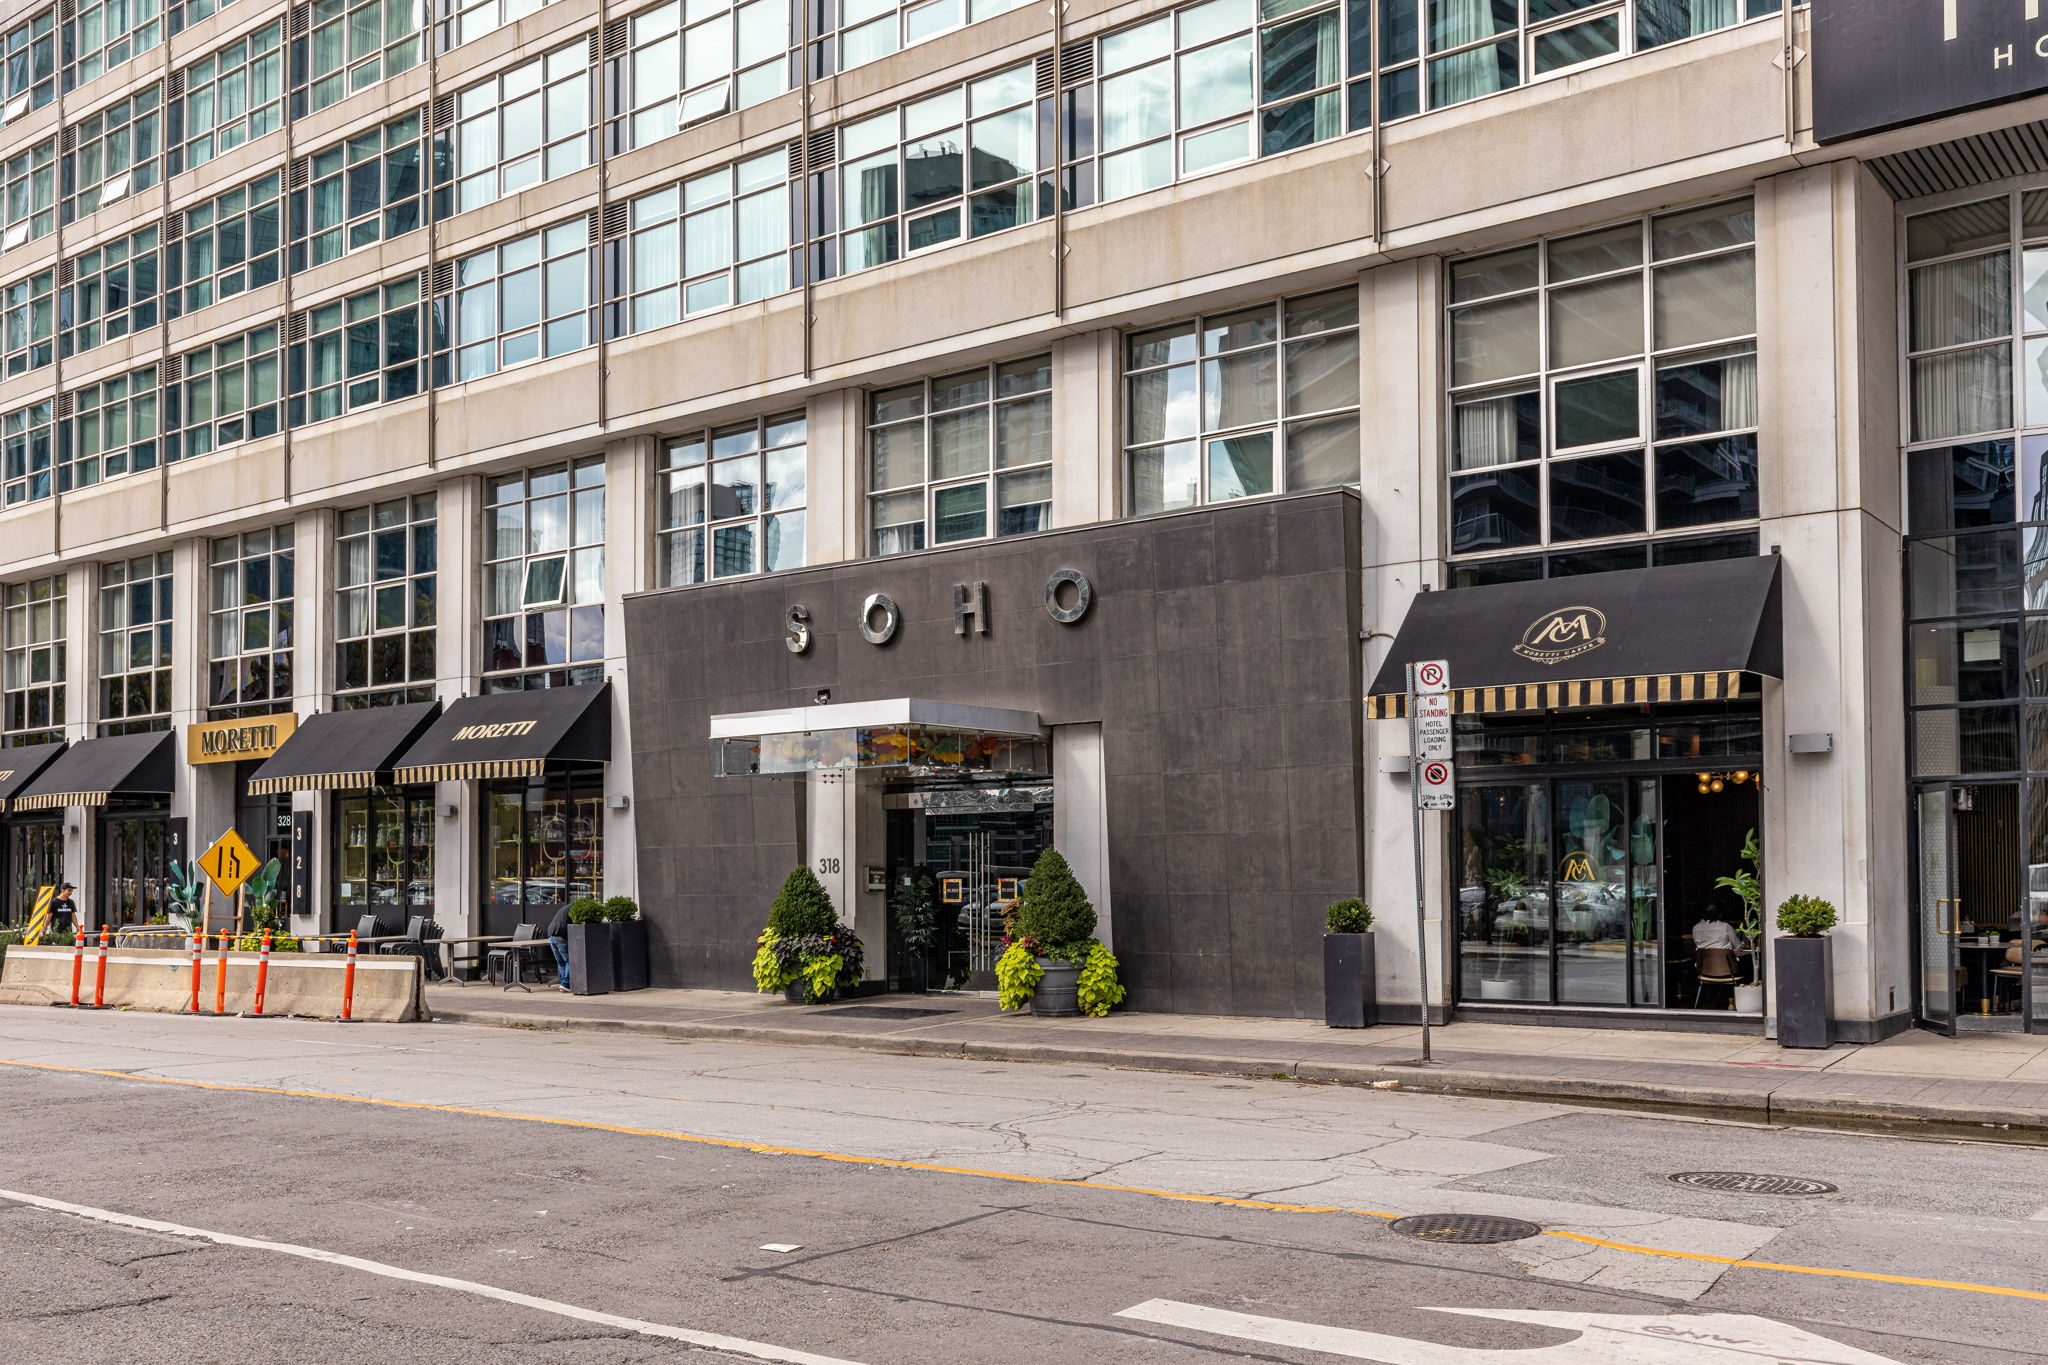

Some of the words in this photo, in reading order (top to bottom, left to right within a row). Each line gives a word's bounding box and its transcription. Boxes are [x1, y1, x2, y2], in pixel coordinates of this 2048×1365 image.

[786, 568, 1093, 653] SOHO
[1428, 697, 1438, 706] NO
[1419, 708, 1448, 718] STANDING
[1425, 720, 1442, 728] HOTEL
[452, 720, 538, 741] MORETTI
[1420, 728, 1450, 736] PASSENGER
[202, 724, 277, 756] MORETTI
[1423, 736, 1447, 744] LOADING
[277, 815, 291, 827] 328
[819, 857, 840, 874] 318
